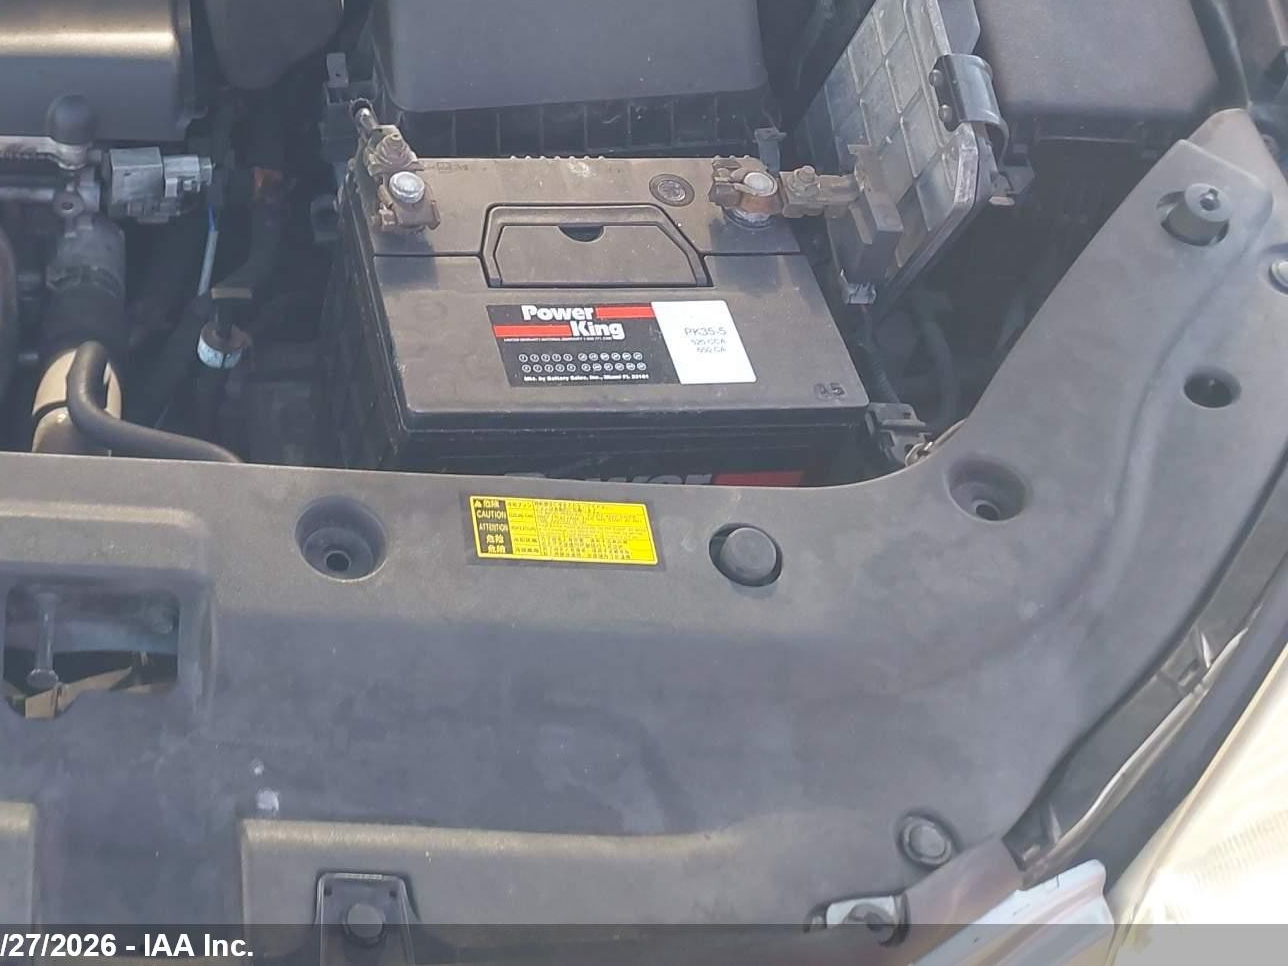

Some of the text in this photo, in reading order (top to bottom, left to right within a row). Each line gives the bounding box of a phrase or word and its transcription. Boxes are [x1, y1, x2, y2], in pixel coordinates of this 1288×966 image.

[521, 305, 594, 321] Power
[569, 320, 625, 340] King
[476, 509, 507, 519] CAUTION
[478, 522, 508, 532] ATTENTION
